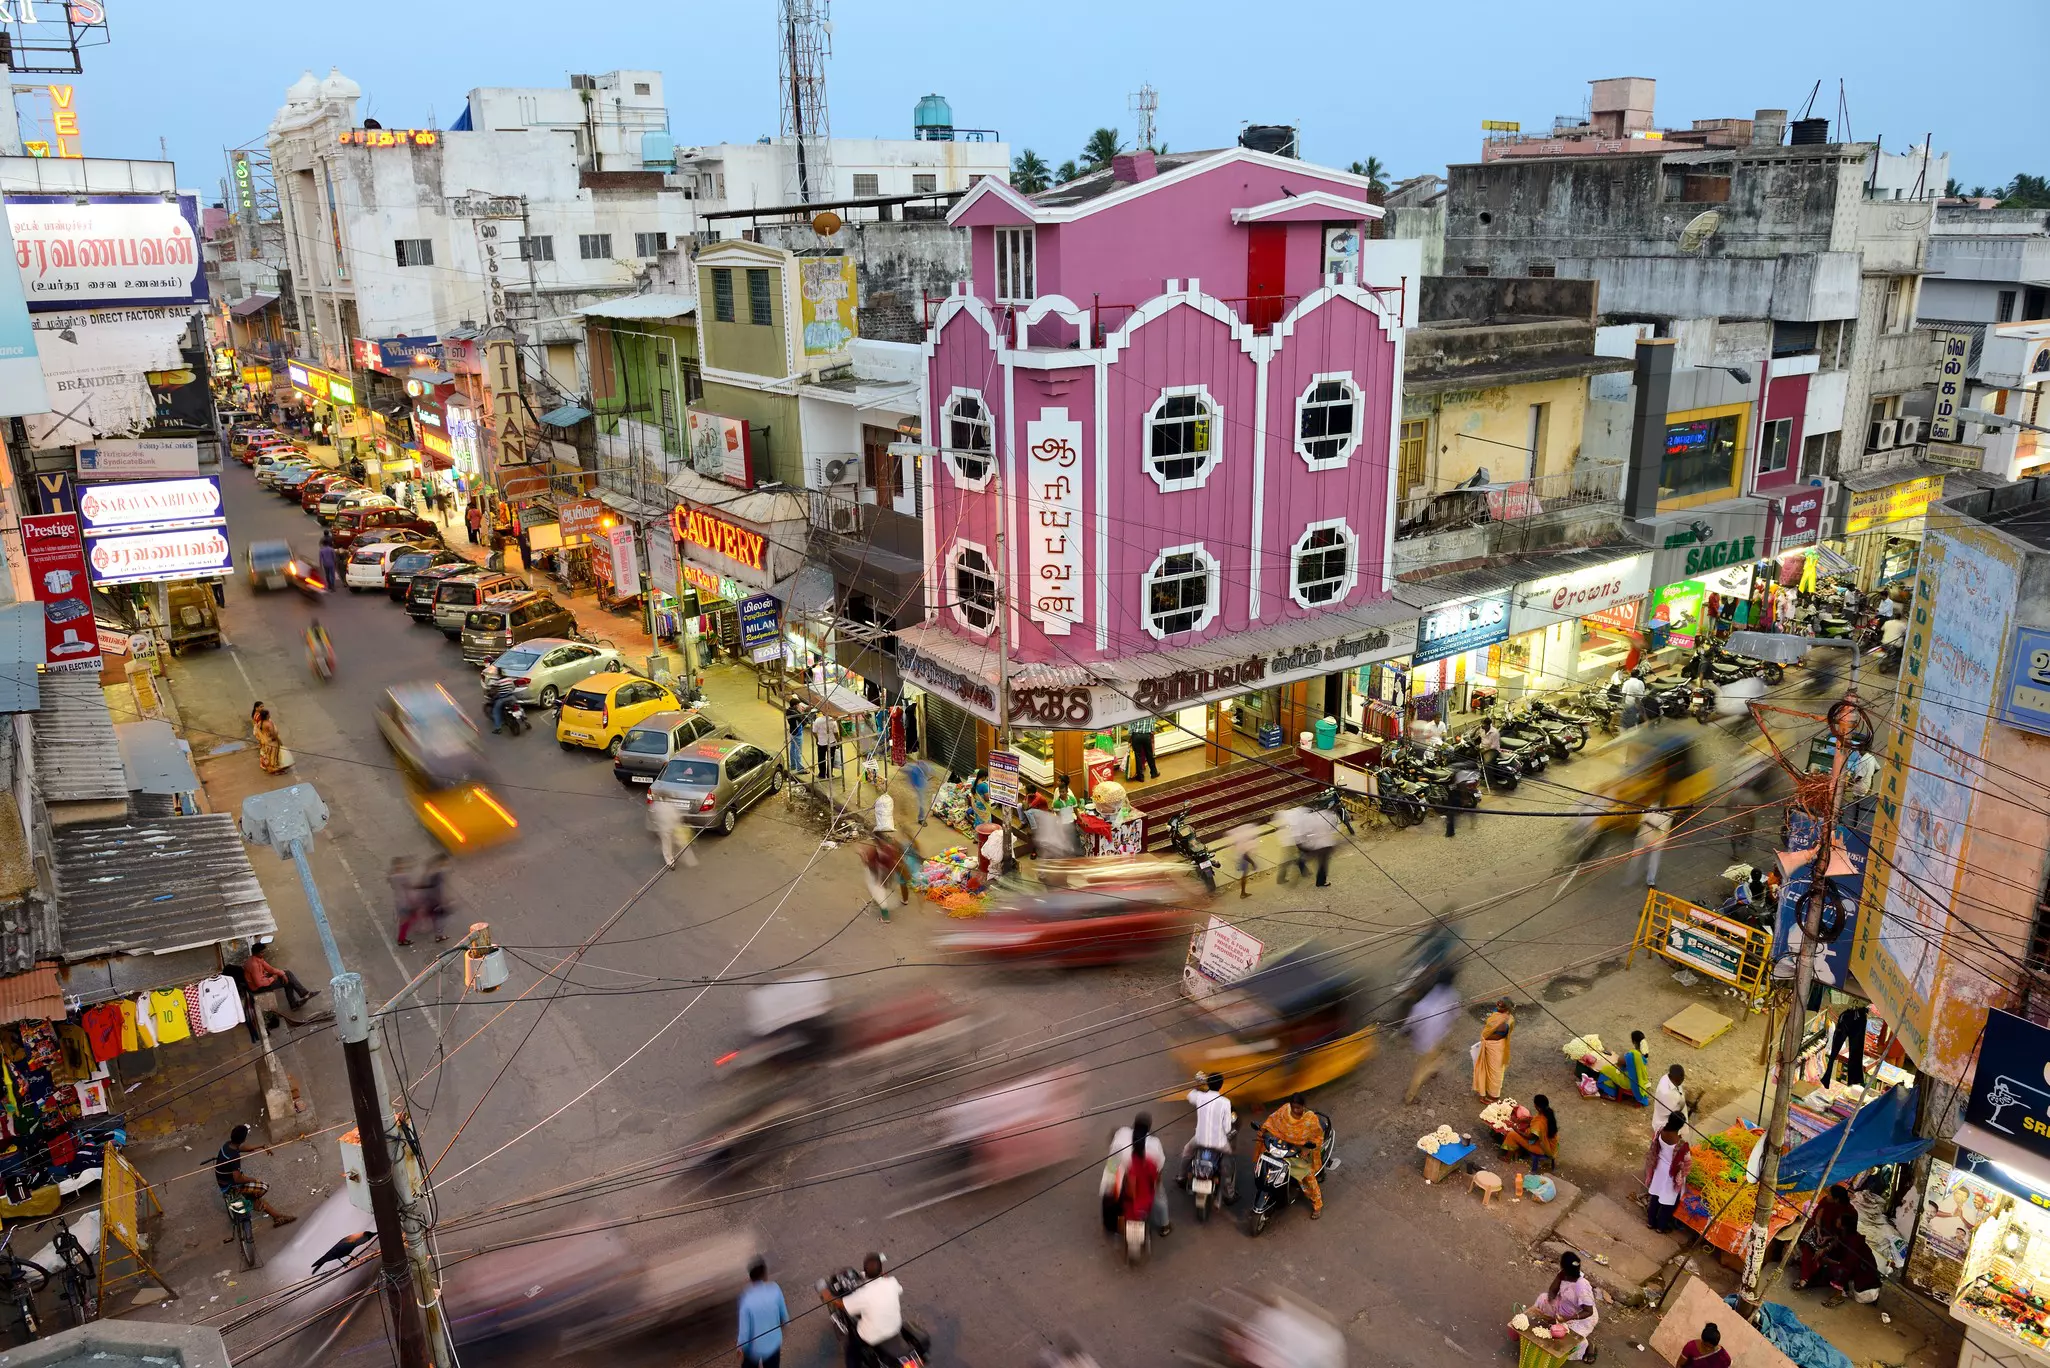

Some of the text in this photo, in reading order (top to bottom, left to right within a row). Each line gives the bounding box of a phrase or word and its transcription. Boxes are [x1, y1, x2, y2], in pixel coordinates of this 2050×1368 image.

[16, 226, 194, 278] சரவணபவன்
[90, 307, 191, 325] DIRECT FACTORY SALE
[489, 341, 525, 464] TITAN
[1901, 480, 1927, 494] WELCOME
[24, 522, 75, 538] Prestige
[675, 504, 763, 570] CAUVERY
[1686, 536, 1756, 575] SAGAR
[746, 620, 776, 634] MILAN
[1416, 647, 1439, 659] COTTON
[68, 661, 94, 671] ELECTRIC
[1008, 688, 1093, 727] ABS
[162, 1009, 174, 1024] 10
